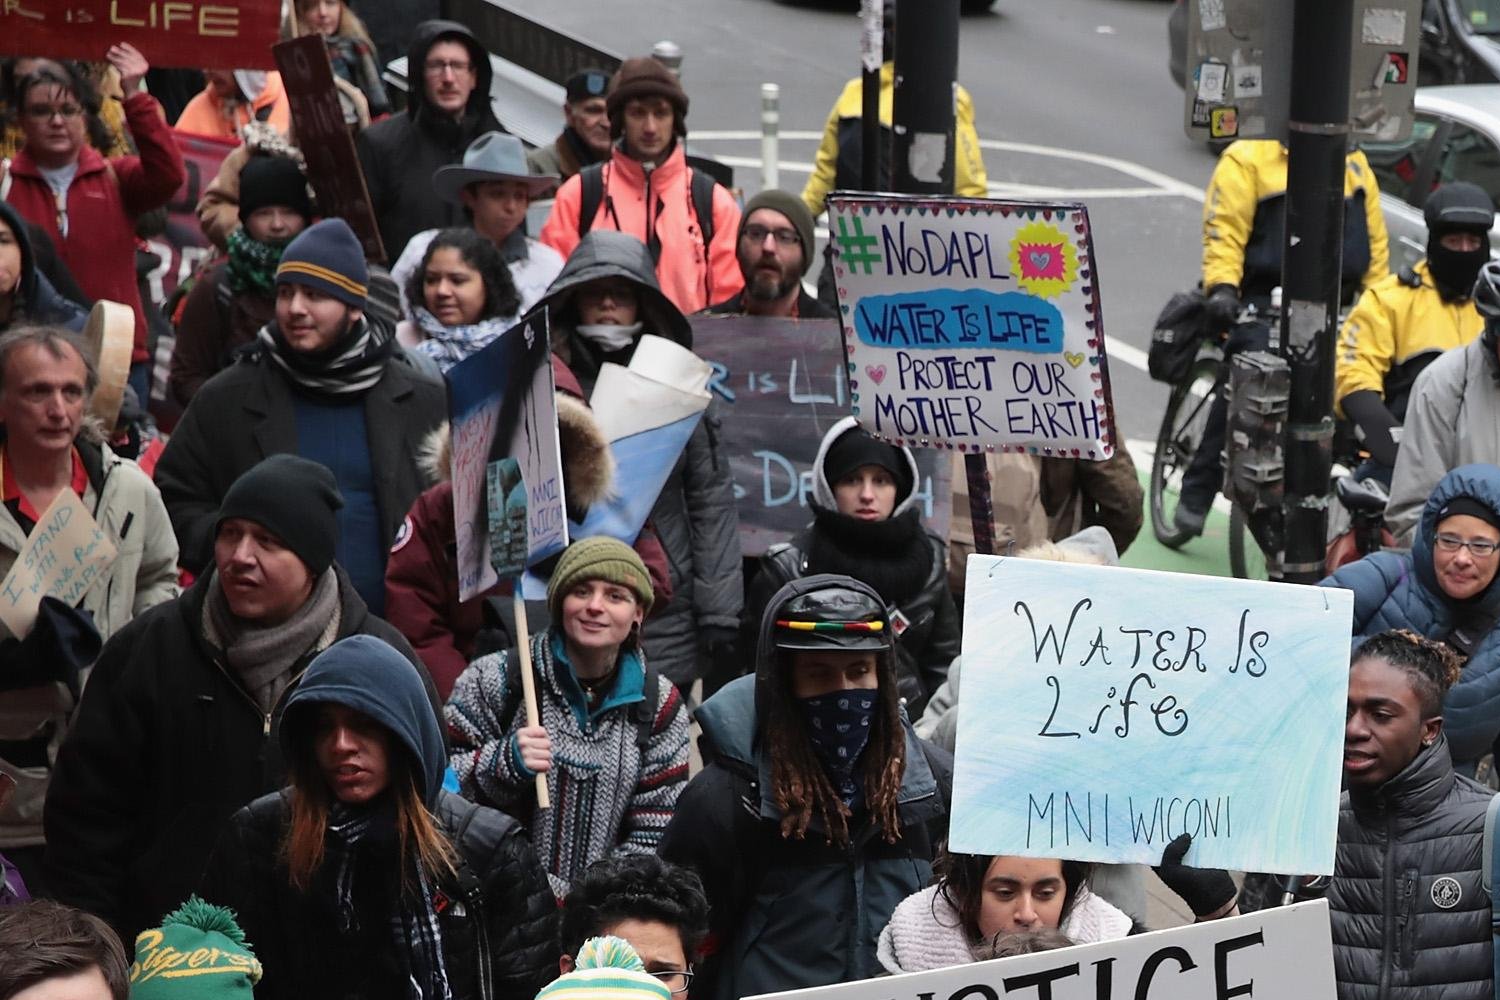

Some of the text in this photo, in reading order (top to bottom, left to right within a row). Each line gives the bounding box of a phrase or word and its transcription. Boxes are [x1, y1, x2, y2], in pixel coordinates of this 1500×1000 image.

[110, 0, 240, 37] LIFE
[859, 303, 950, 345] WATER
[984, 304, 1051, 345] LIFE
[896, 351, 1076, 398] PROTECT OUR
[874, 393, 1101, 440] MOTHER EARTH
[1013, 597, 1208, 673] WATER
[1025, 791, 1232, 850] MNI WICONI
